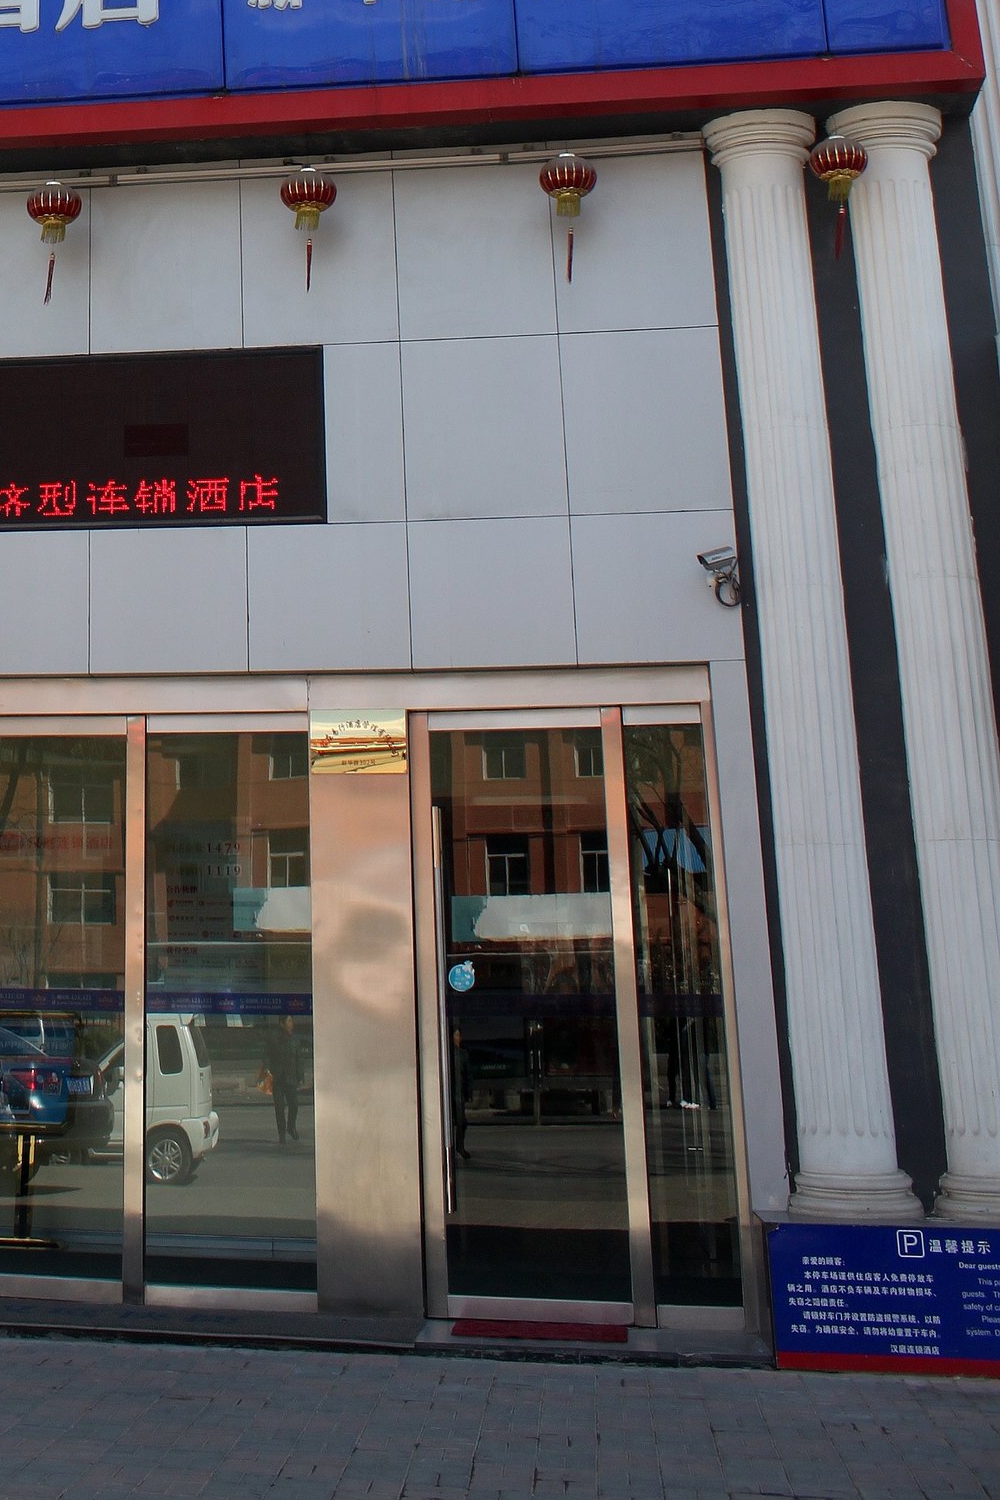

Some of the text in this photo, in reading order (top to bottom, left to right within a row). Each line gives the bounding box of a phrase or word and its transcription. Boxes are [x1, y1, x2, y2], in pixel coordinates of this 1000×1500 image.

[928, 1239, 991, 1255] 温馨提示
[958, 1261, 976, 1269] Dear
[977, 1278, 993, 1286] This
[963, 1302, 984, 1312] safety
